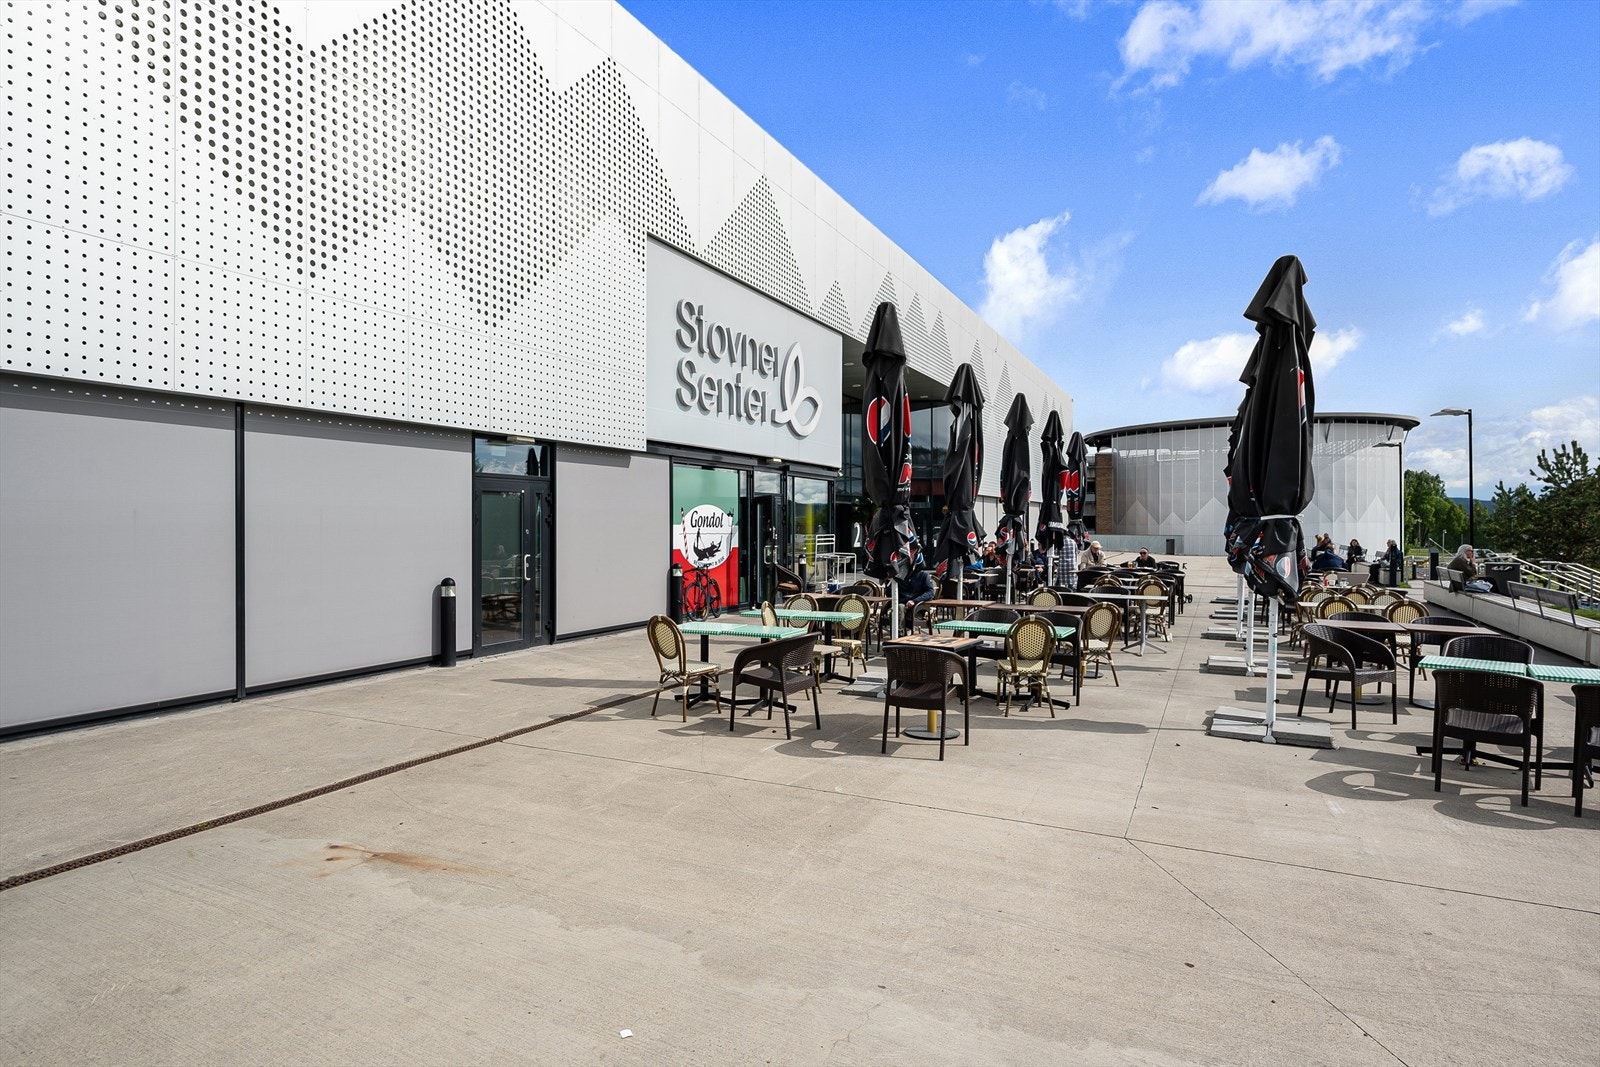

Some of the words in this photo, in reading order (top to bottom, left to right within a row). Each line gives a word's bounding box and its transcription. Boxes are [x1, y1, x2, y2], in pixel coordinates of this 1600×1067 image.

[675, 299, 779, 379] Stovner
[675, 357, 768, 425] Senter
[690, 510, 724, 528] Gondol
[853, 521, 861, 548] 2
